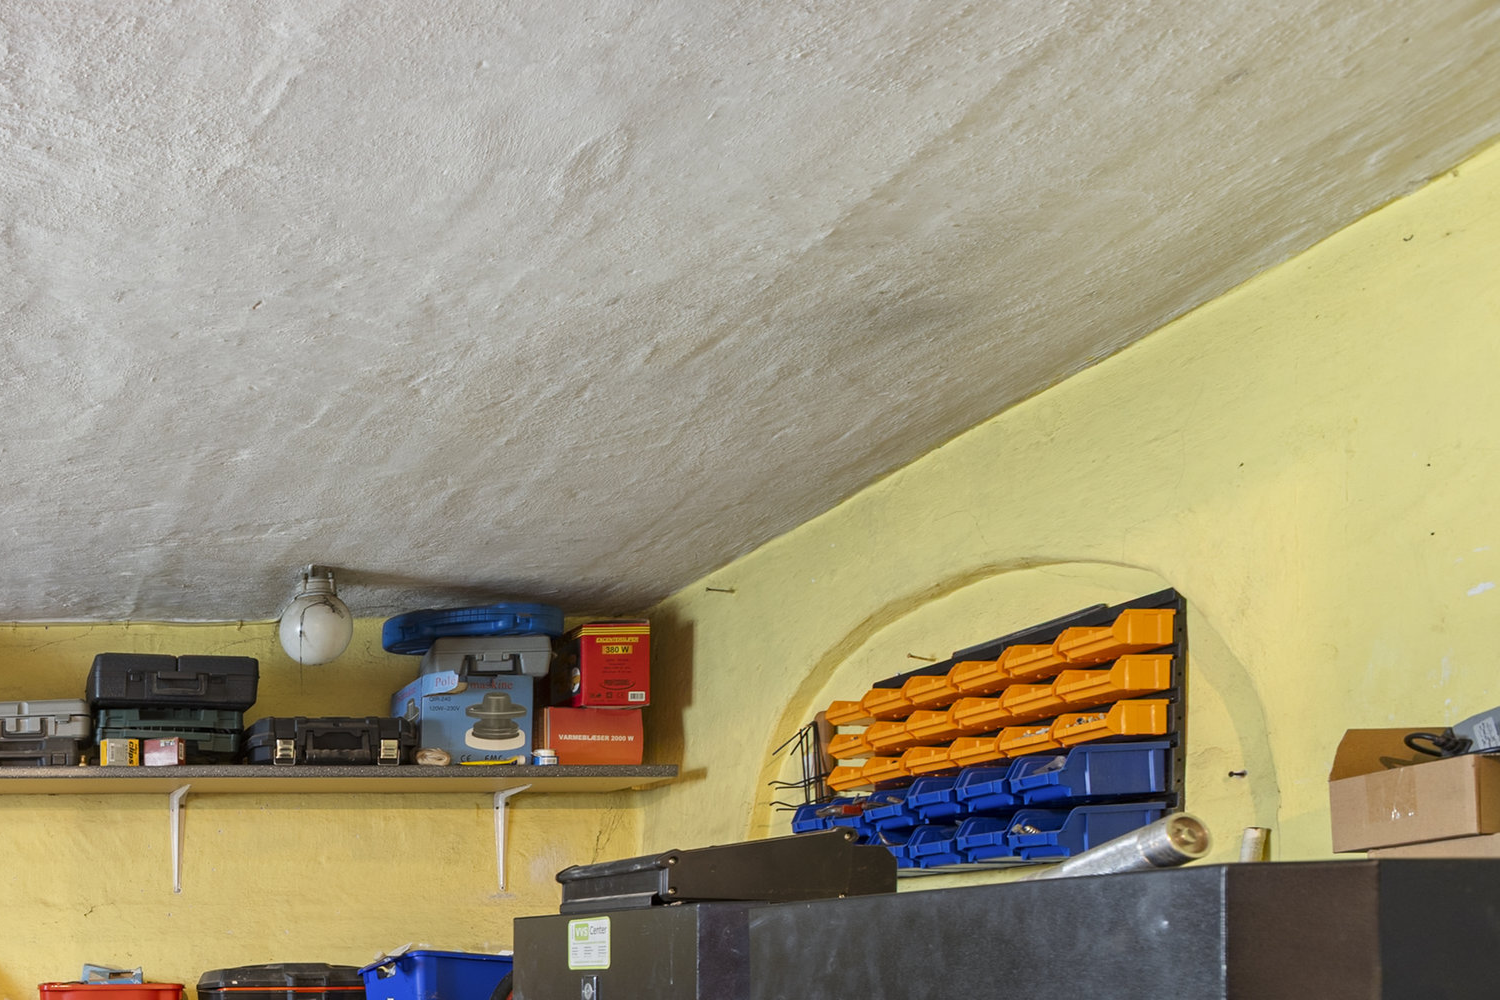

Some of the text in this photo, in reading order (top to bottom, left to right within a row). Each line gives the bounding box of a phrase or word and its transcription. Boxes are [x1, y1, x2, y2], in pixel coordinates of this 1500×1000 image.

[558, 734, 610, 742] VARMEBLÆSER
[576, 925, 608, 937] VVS Center
